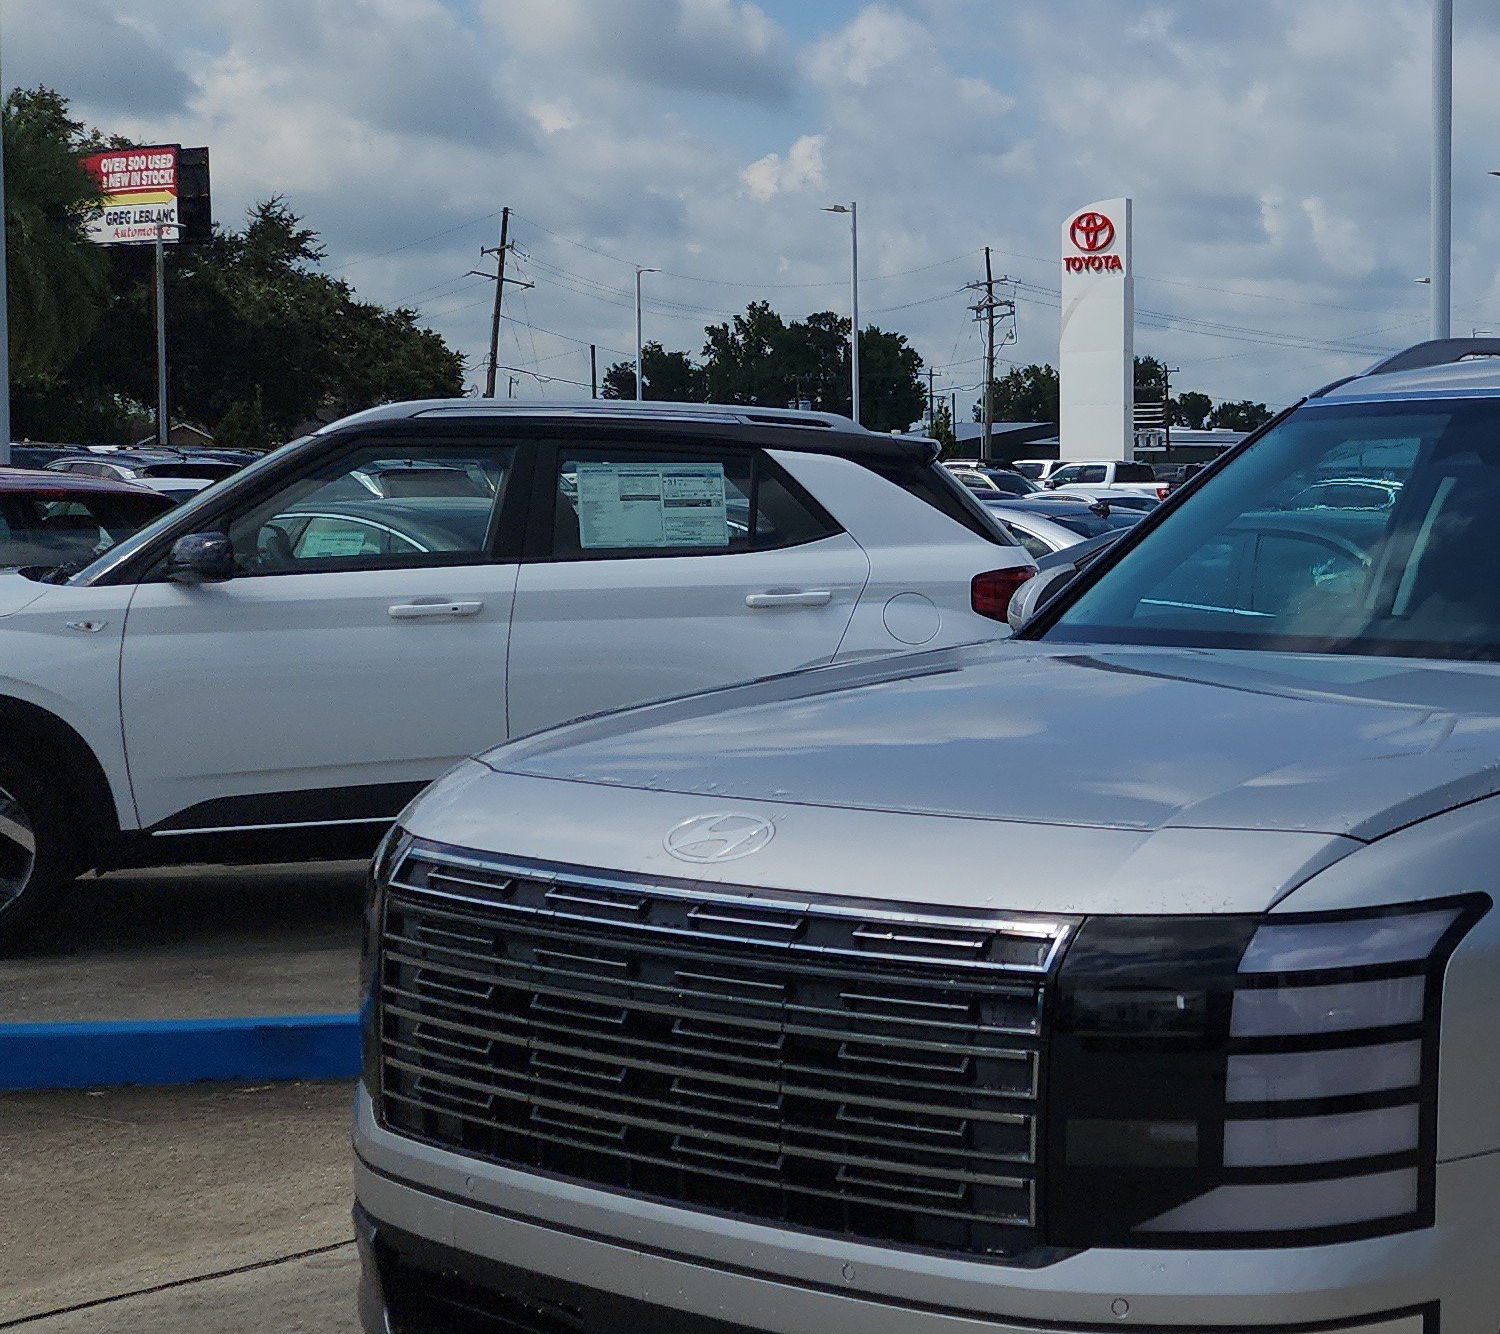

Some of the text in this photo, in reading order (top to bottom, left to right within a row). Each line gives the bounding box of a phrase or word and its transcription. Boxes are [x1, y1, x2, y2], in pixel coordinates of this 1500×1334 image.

[101, 154, 174, 173] OVER 500 USED
[108, 171, 130, 187] NEW
[131, 171, 141, 185] IN
[106, 208, 176, 225] GREG LEBLANC
[1063, 254, 1123, 272] TOYOTA
